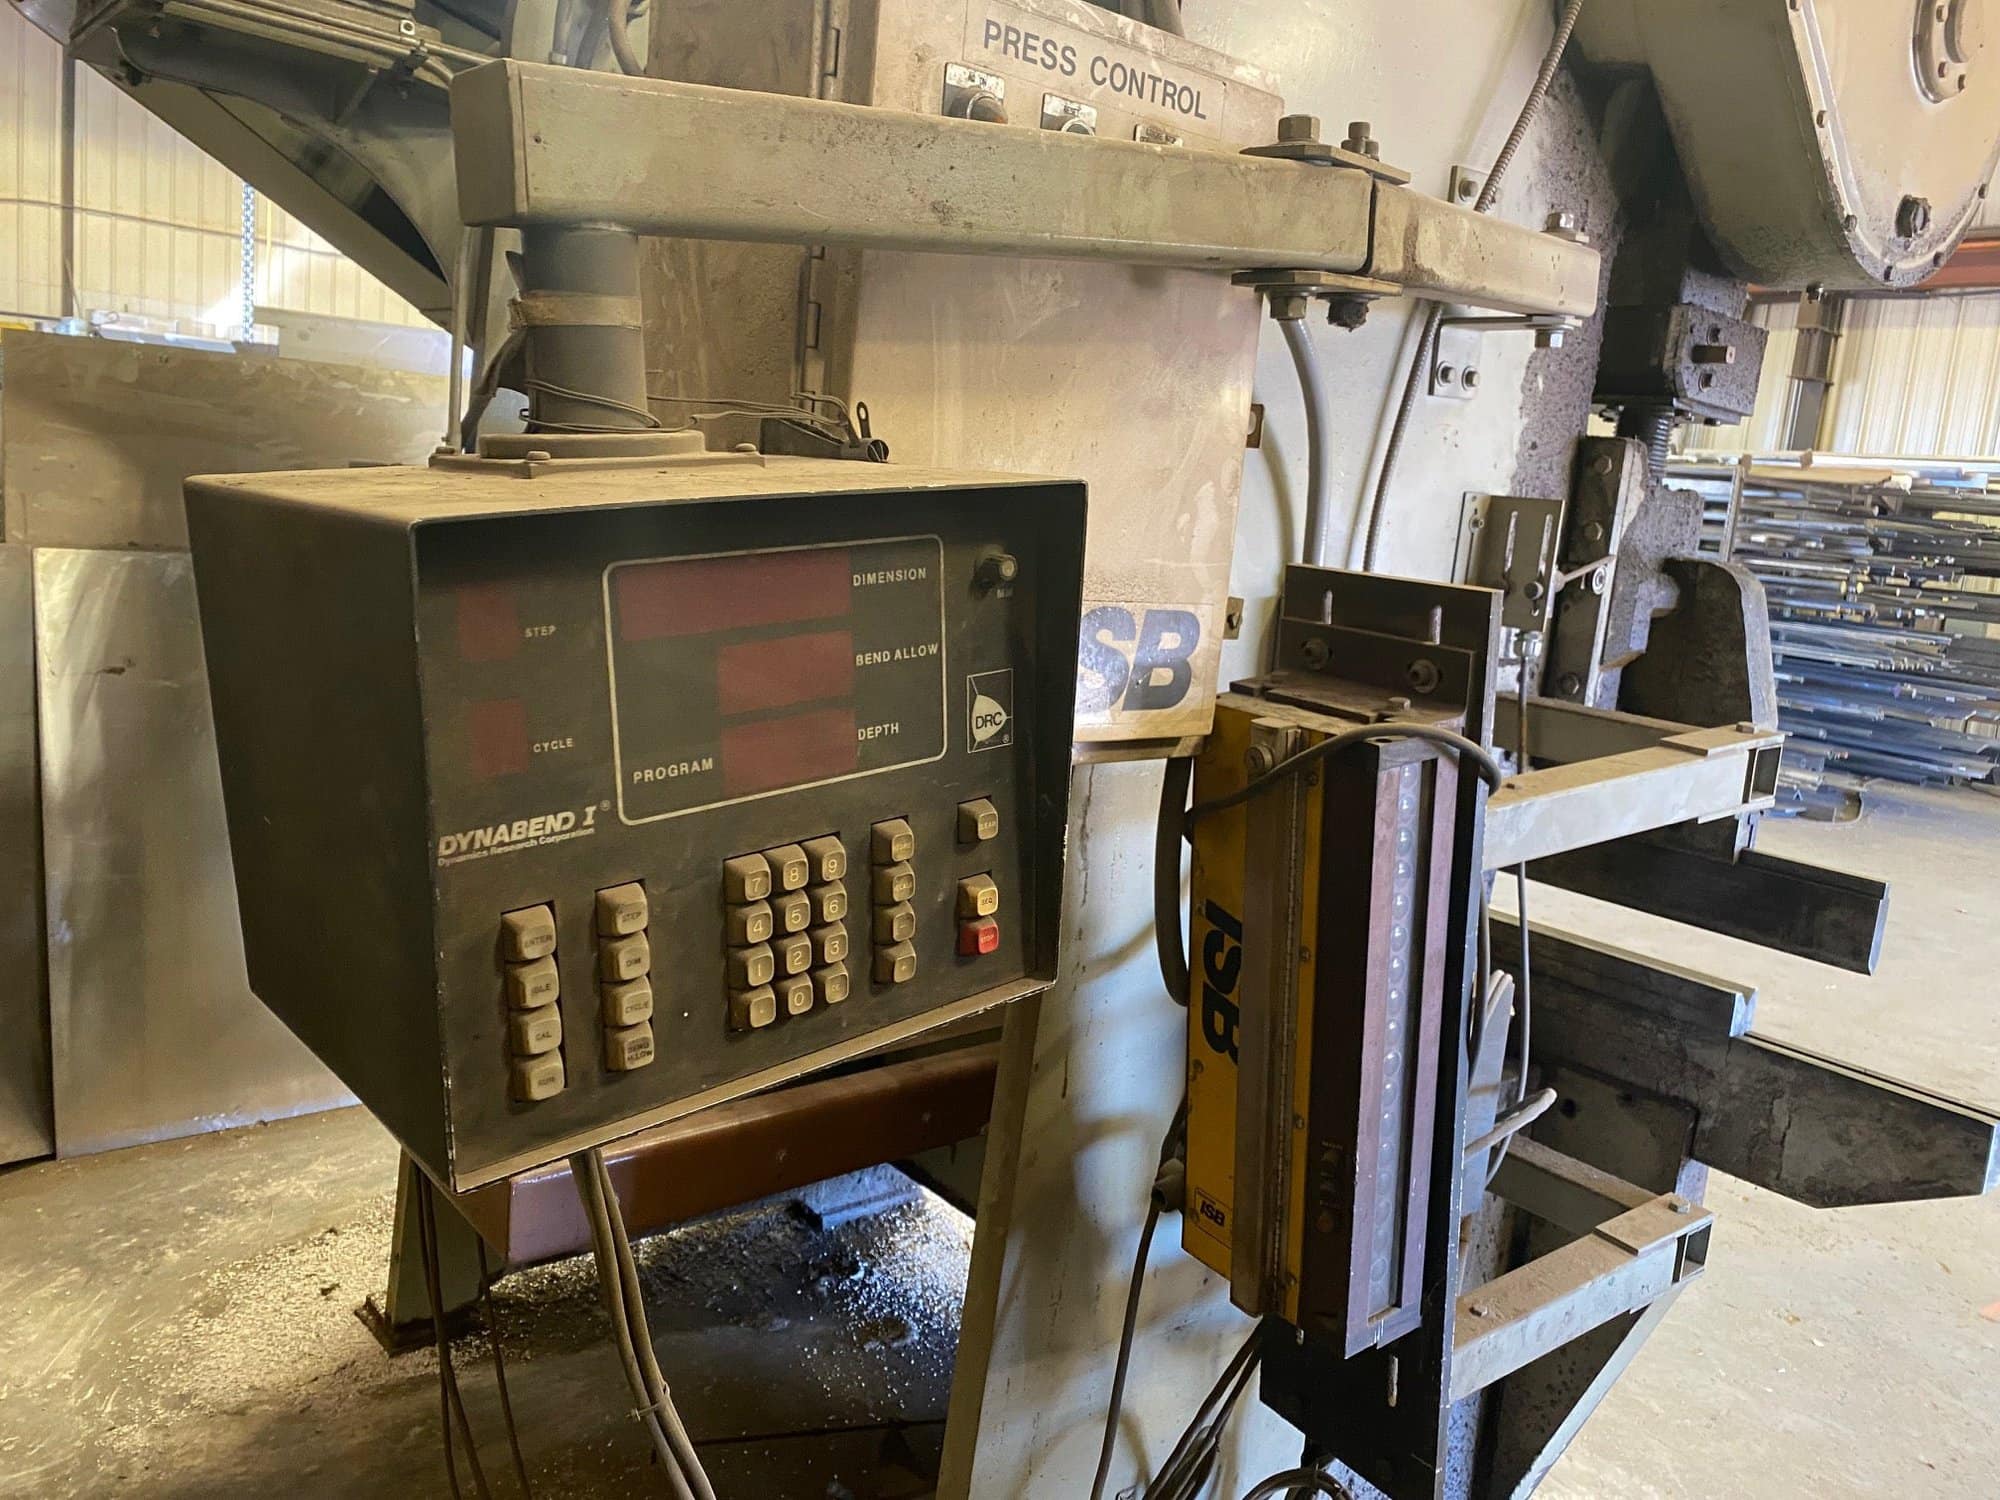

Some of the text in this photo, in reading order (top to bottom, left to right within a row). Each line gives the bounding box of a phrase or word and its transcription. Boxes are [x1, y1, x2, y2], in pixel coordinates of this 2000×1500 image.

[983, 19, 1207, 120] PRESS CONTROL
[853, 567, 927, 587] DIMENSION
[525, 625, 556, 638] STEP
[856, 643, 939, 666] BEND ALLOW
[975, 712, 1003, 730] DRC
[858, 722, 900, 741] DEPTH
[533, 738, 574, 753] CYCLE
[633, 757, 714, 784] PROGRAM
[438, 811, 576, 857] DYNABEND
[490, 839, 538, 855] Research
[538, 827, 595, 845] Corporation
[828, 858, 838, 873] 9
[789, 868, 799, 882] 8
[751, 877, 761, 892] 7
[829, 899, 839, 914] 6
[791, 909, 801, 924] 5
[752, 919, 763, 934] 4
[792, 948, 802, 962] 2
[830, 940, 840, 955] 3
[794, 992, 804, 1006] 0
[1200, 1200, 1226, 1227] ISB
